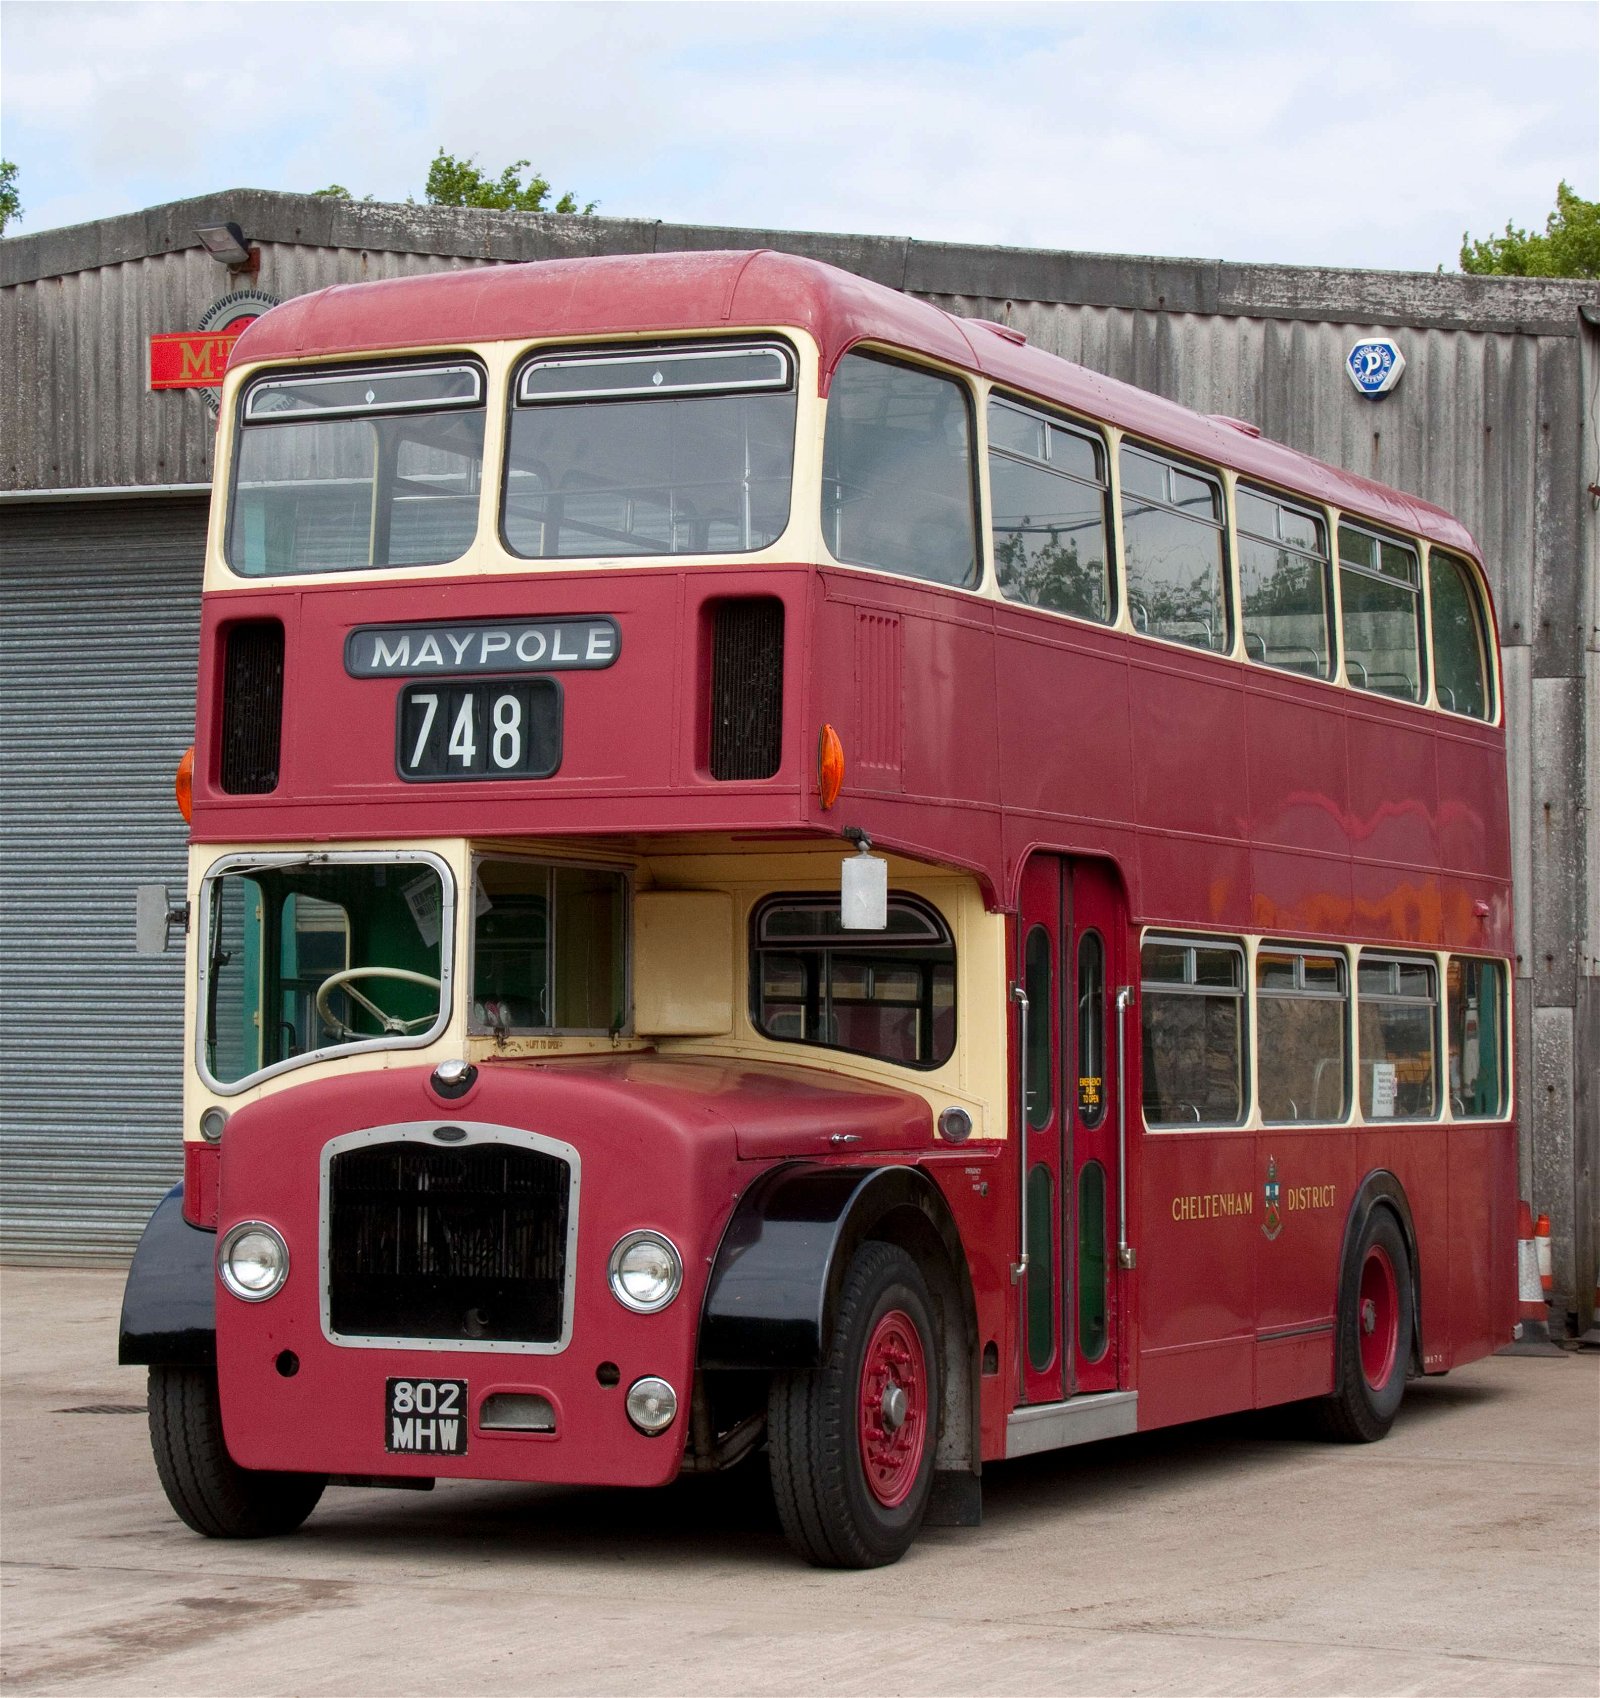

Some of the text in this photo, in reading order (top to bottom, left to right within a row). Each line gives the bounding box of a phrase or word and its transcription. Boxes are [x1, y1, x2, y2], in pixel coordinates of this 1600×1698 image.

[1354, 345, 1391, 369] PATROL ALARM
[1365, 352, 1381, 376] P
[1356, 370, 1388, 384] SYSTEMS
[371, 627, 615, 667] MAYPOLE
[410, 693, 522, 769] 748
[530, 1040, 539, 1050] LIFT
[540, 1040, 546, 1050] TO
[1172, 1185, 1336, 1221] CHELTENHAM DISTRICT
[393, 1381, 460, 1415] 802
[392, 1417, 459, 1451] MHW
